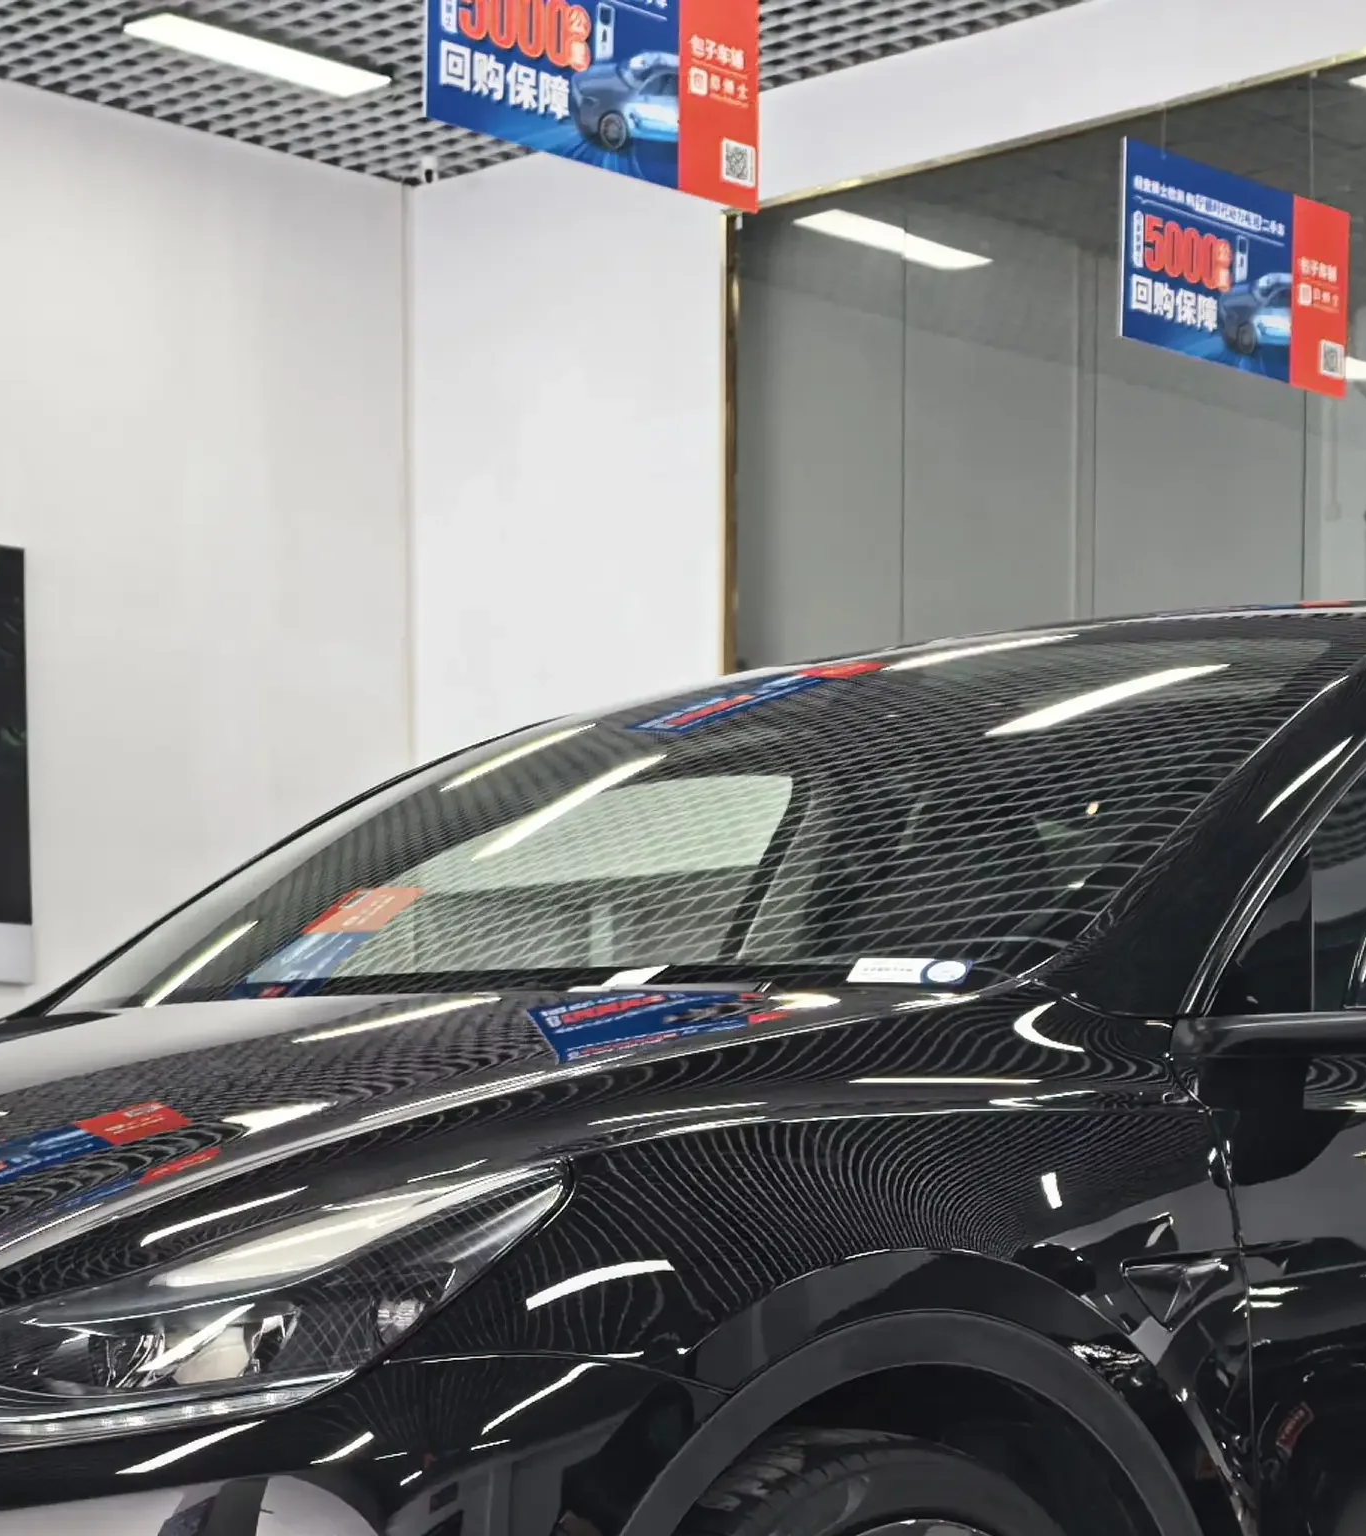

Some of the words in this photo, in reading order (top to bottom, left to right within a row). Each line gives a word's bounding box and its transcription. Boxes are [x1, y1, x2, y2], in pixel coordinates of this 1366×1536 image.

[439, 39, 570, 120] 回购保障
[1145, 214, 1216, 288] 5000
[1131, 274, 1219, 332] 回购保障
